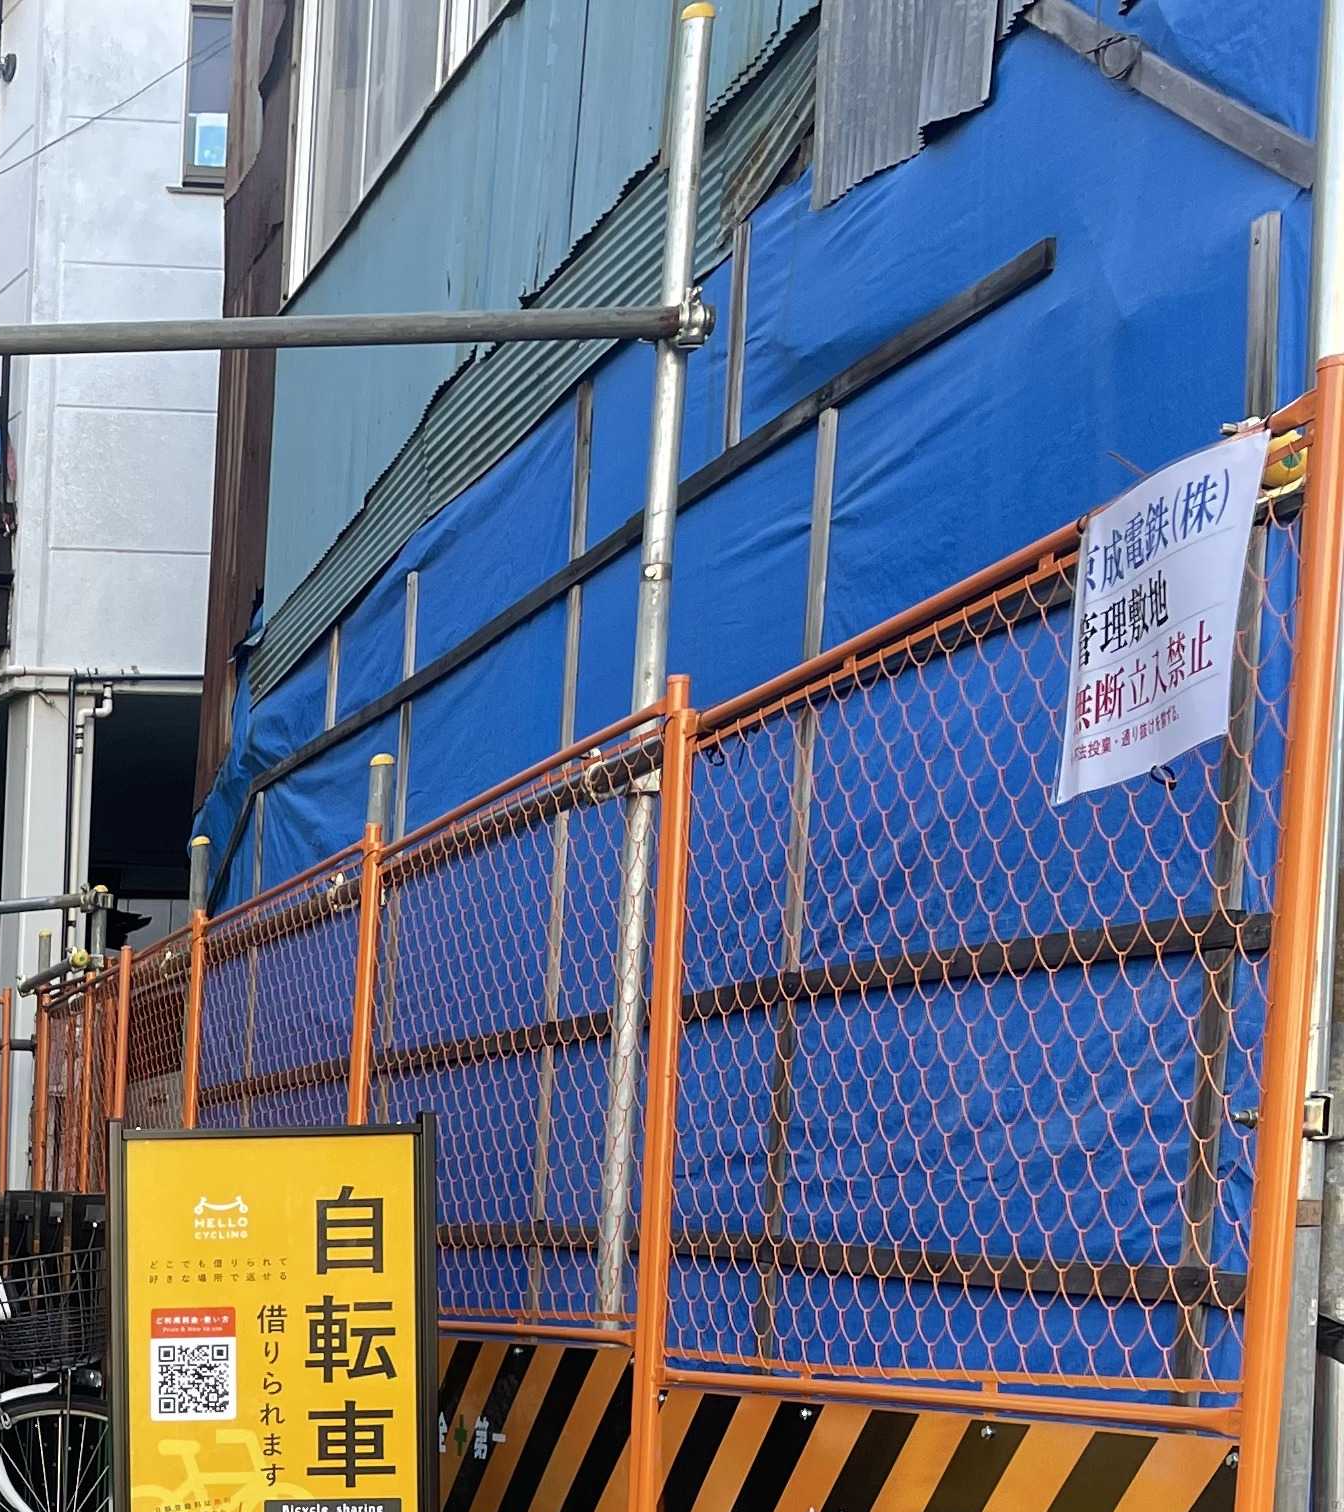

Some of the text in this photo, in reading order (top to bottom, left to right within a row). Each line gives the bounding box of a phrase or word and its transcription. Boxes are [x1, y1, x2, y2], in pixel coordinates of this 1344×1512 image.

[194, 1217, 248, 1228] HELLO
[194, 1231, 248, 1240] CYCLING
[150, 1257, 288, 1270] どこでも借りられて
[305, 1186, 397, 1488] 自転車
[257, 1304, 288, 1487] 借りられます
